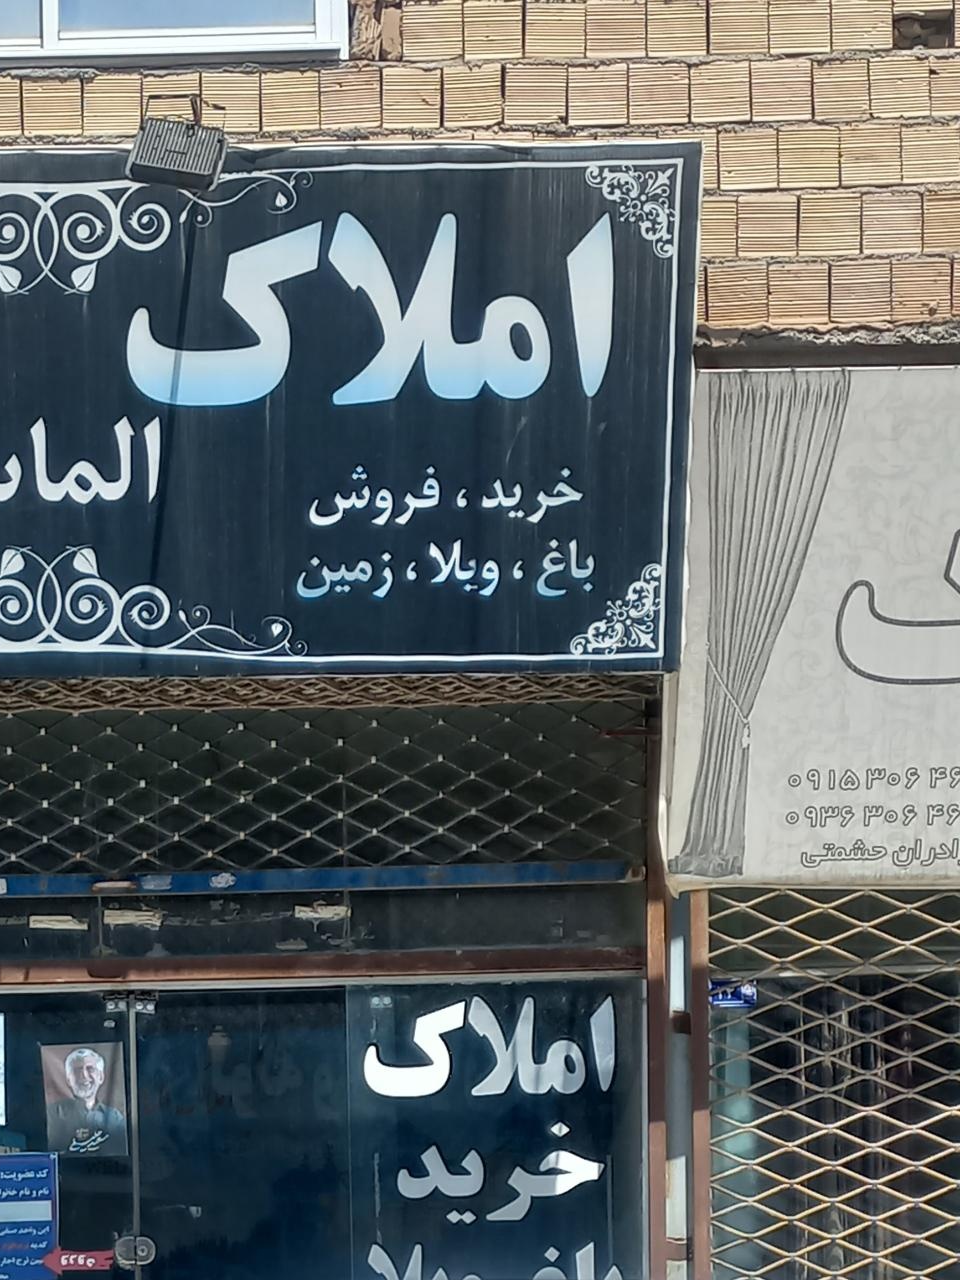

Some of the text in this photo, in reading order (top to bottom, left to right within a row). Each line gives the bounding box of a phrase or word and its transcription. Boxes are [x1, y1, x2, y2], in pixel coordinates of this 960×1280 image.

[126, 212, 615, 406] املاک
[308, 465, 440, 526] فروش
[481, 468, 583, 522] خرید
[296, 550, 393, 598] زمین
[428, 541, 500, 597] ویلا
[537, 539, 595, 597] باغ
[801, 838, 888, 868] حشمتی
[364, 995, 616, 1098] املاک
[396, 1121, 605, 1223] خرید
